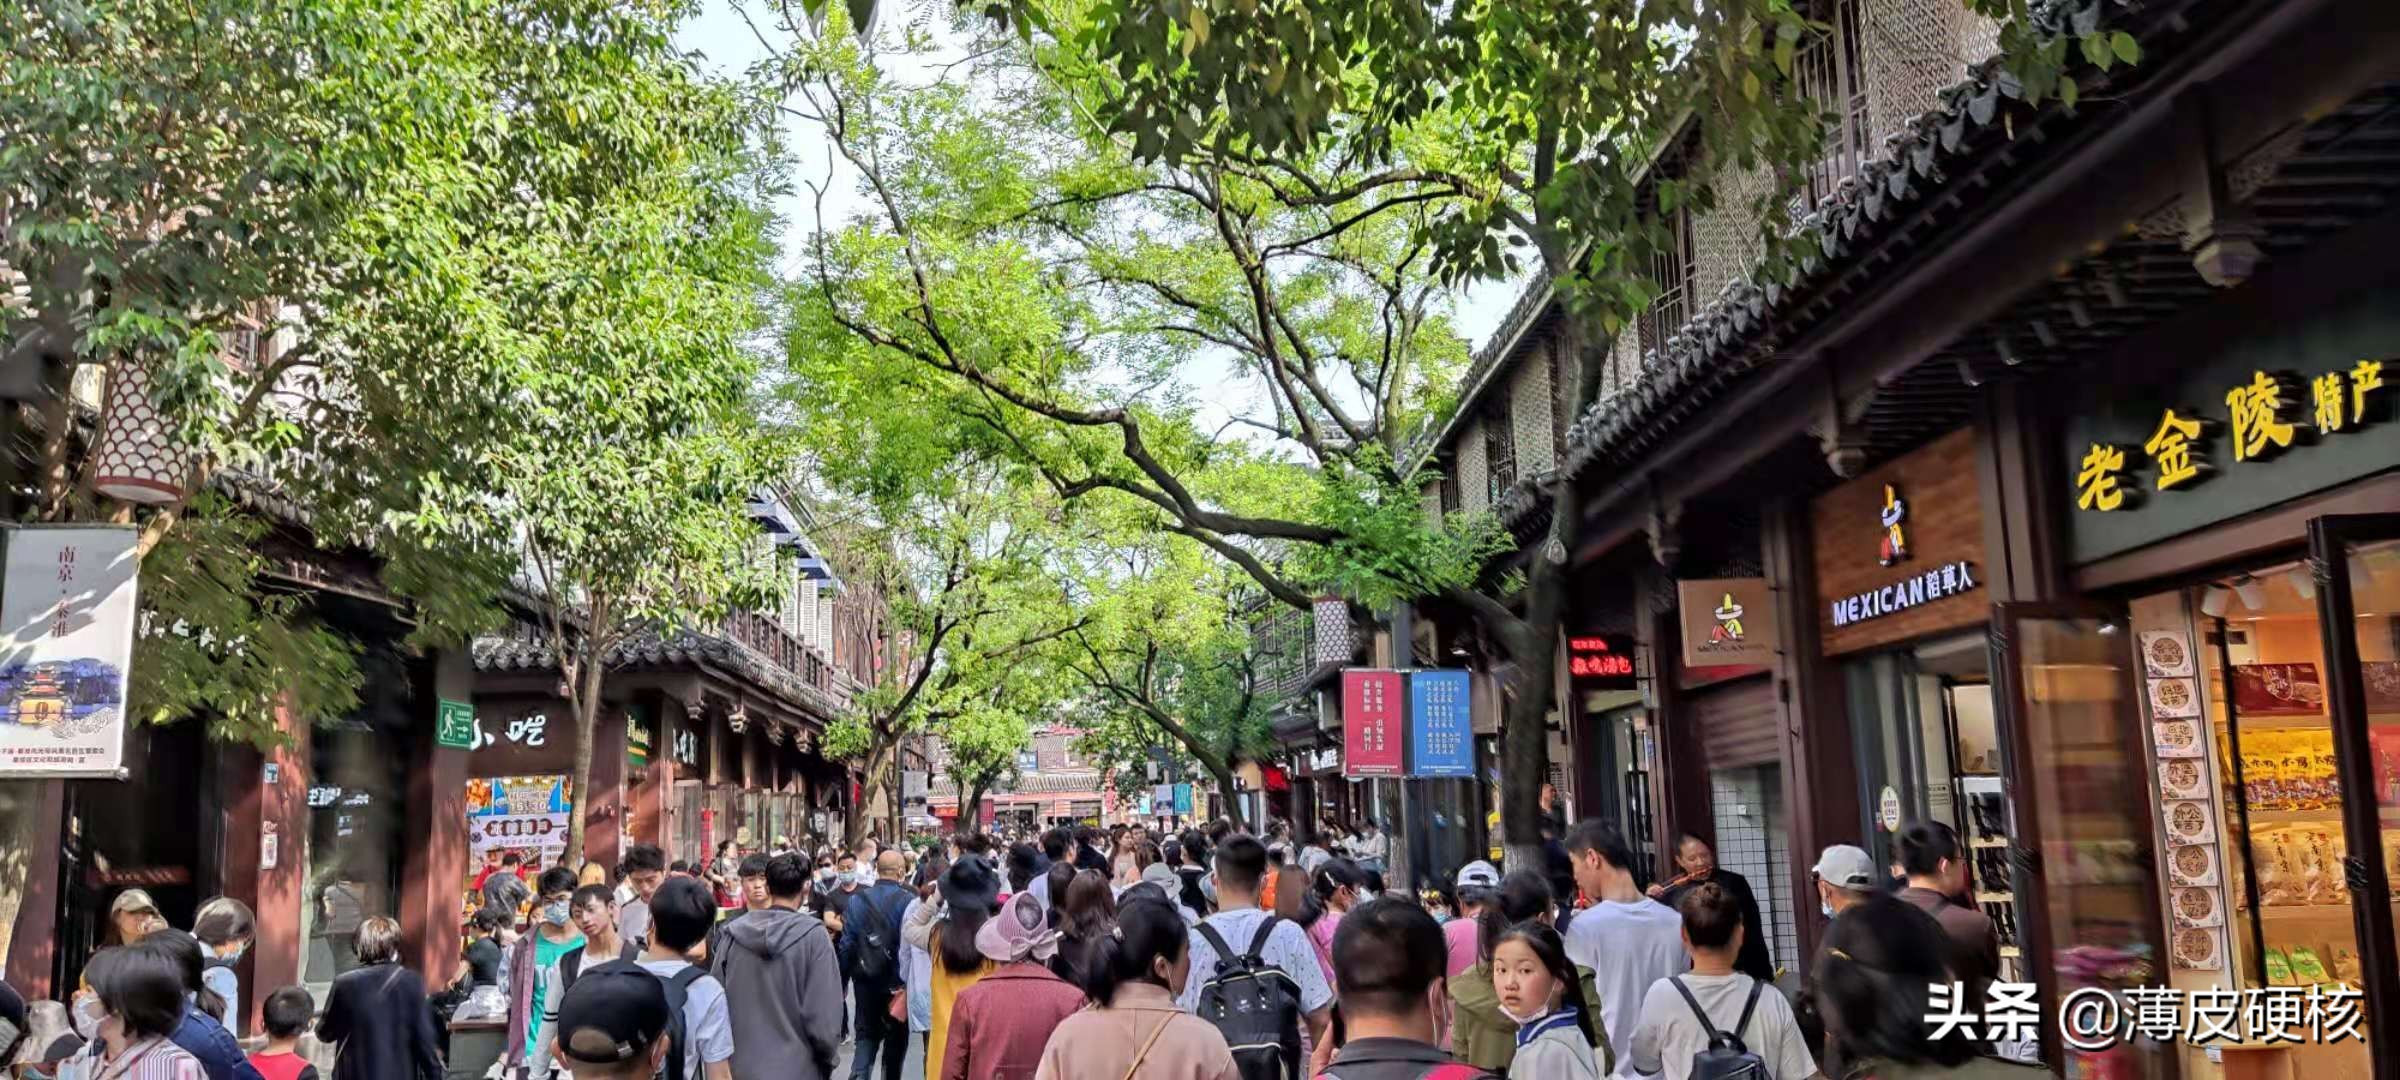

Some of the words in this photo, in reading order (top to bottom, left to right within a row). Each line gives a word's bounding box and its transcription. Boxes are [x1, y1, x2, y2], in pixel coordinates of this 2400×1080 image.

[2077, 370, 2295, 511] 老金陵
[2312, 360, 2383, 435] 特产
[1833, 576, 1923, 627] MEXICAN
[1926, 560, 1974, 600] 稻草人
